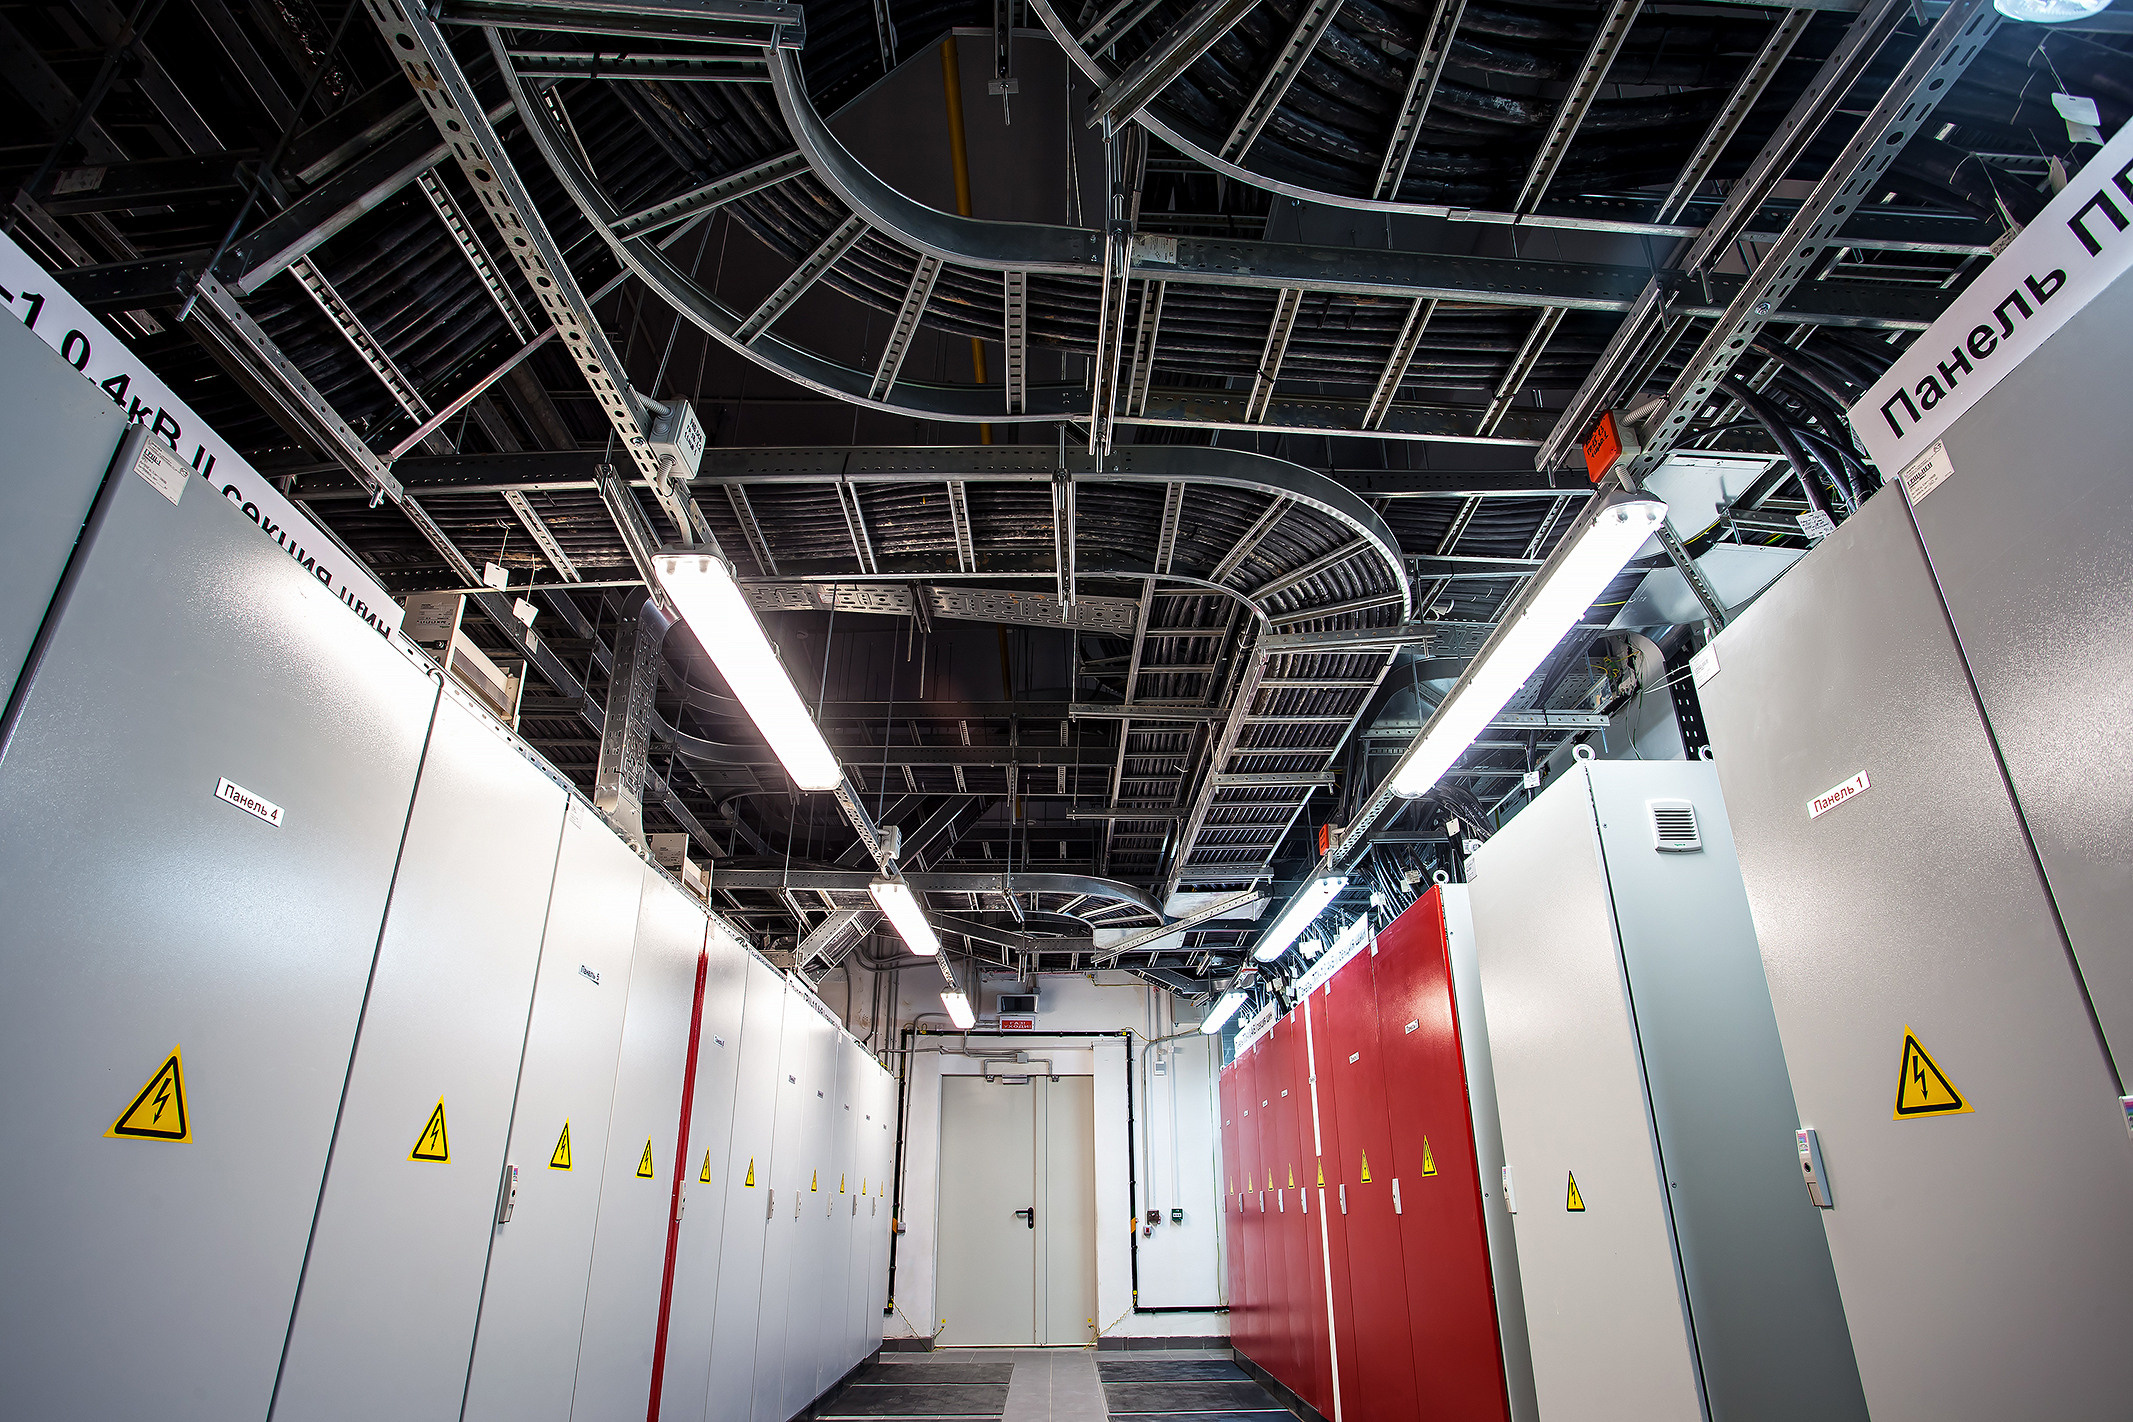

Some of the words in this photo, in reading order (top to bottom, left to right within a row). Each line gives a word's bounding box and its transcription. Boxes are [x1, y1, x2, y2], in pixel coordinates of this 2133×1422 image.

[60, 329, 182, 453] 04кВ
[1880, 269, 2067, 439] Панель
[224, 784, 268, 816] Панель
[270, 809, 278, 821] 4
[1813, 785, 1855, 813] Панель
[1856, 776, 1863, 788] 1
